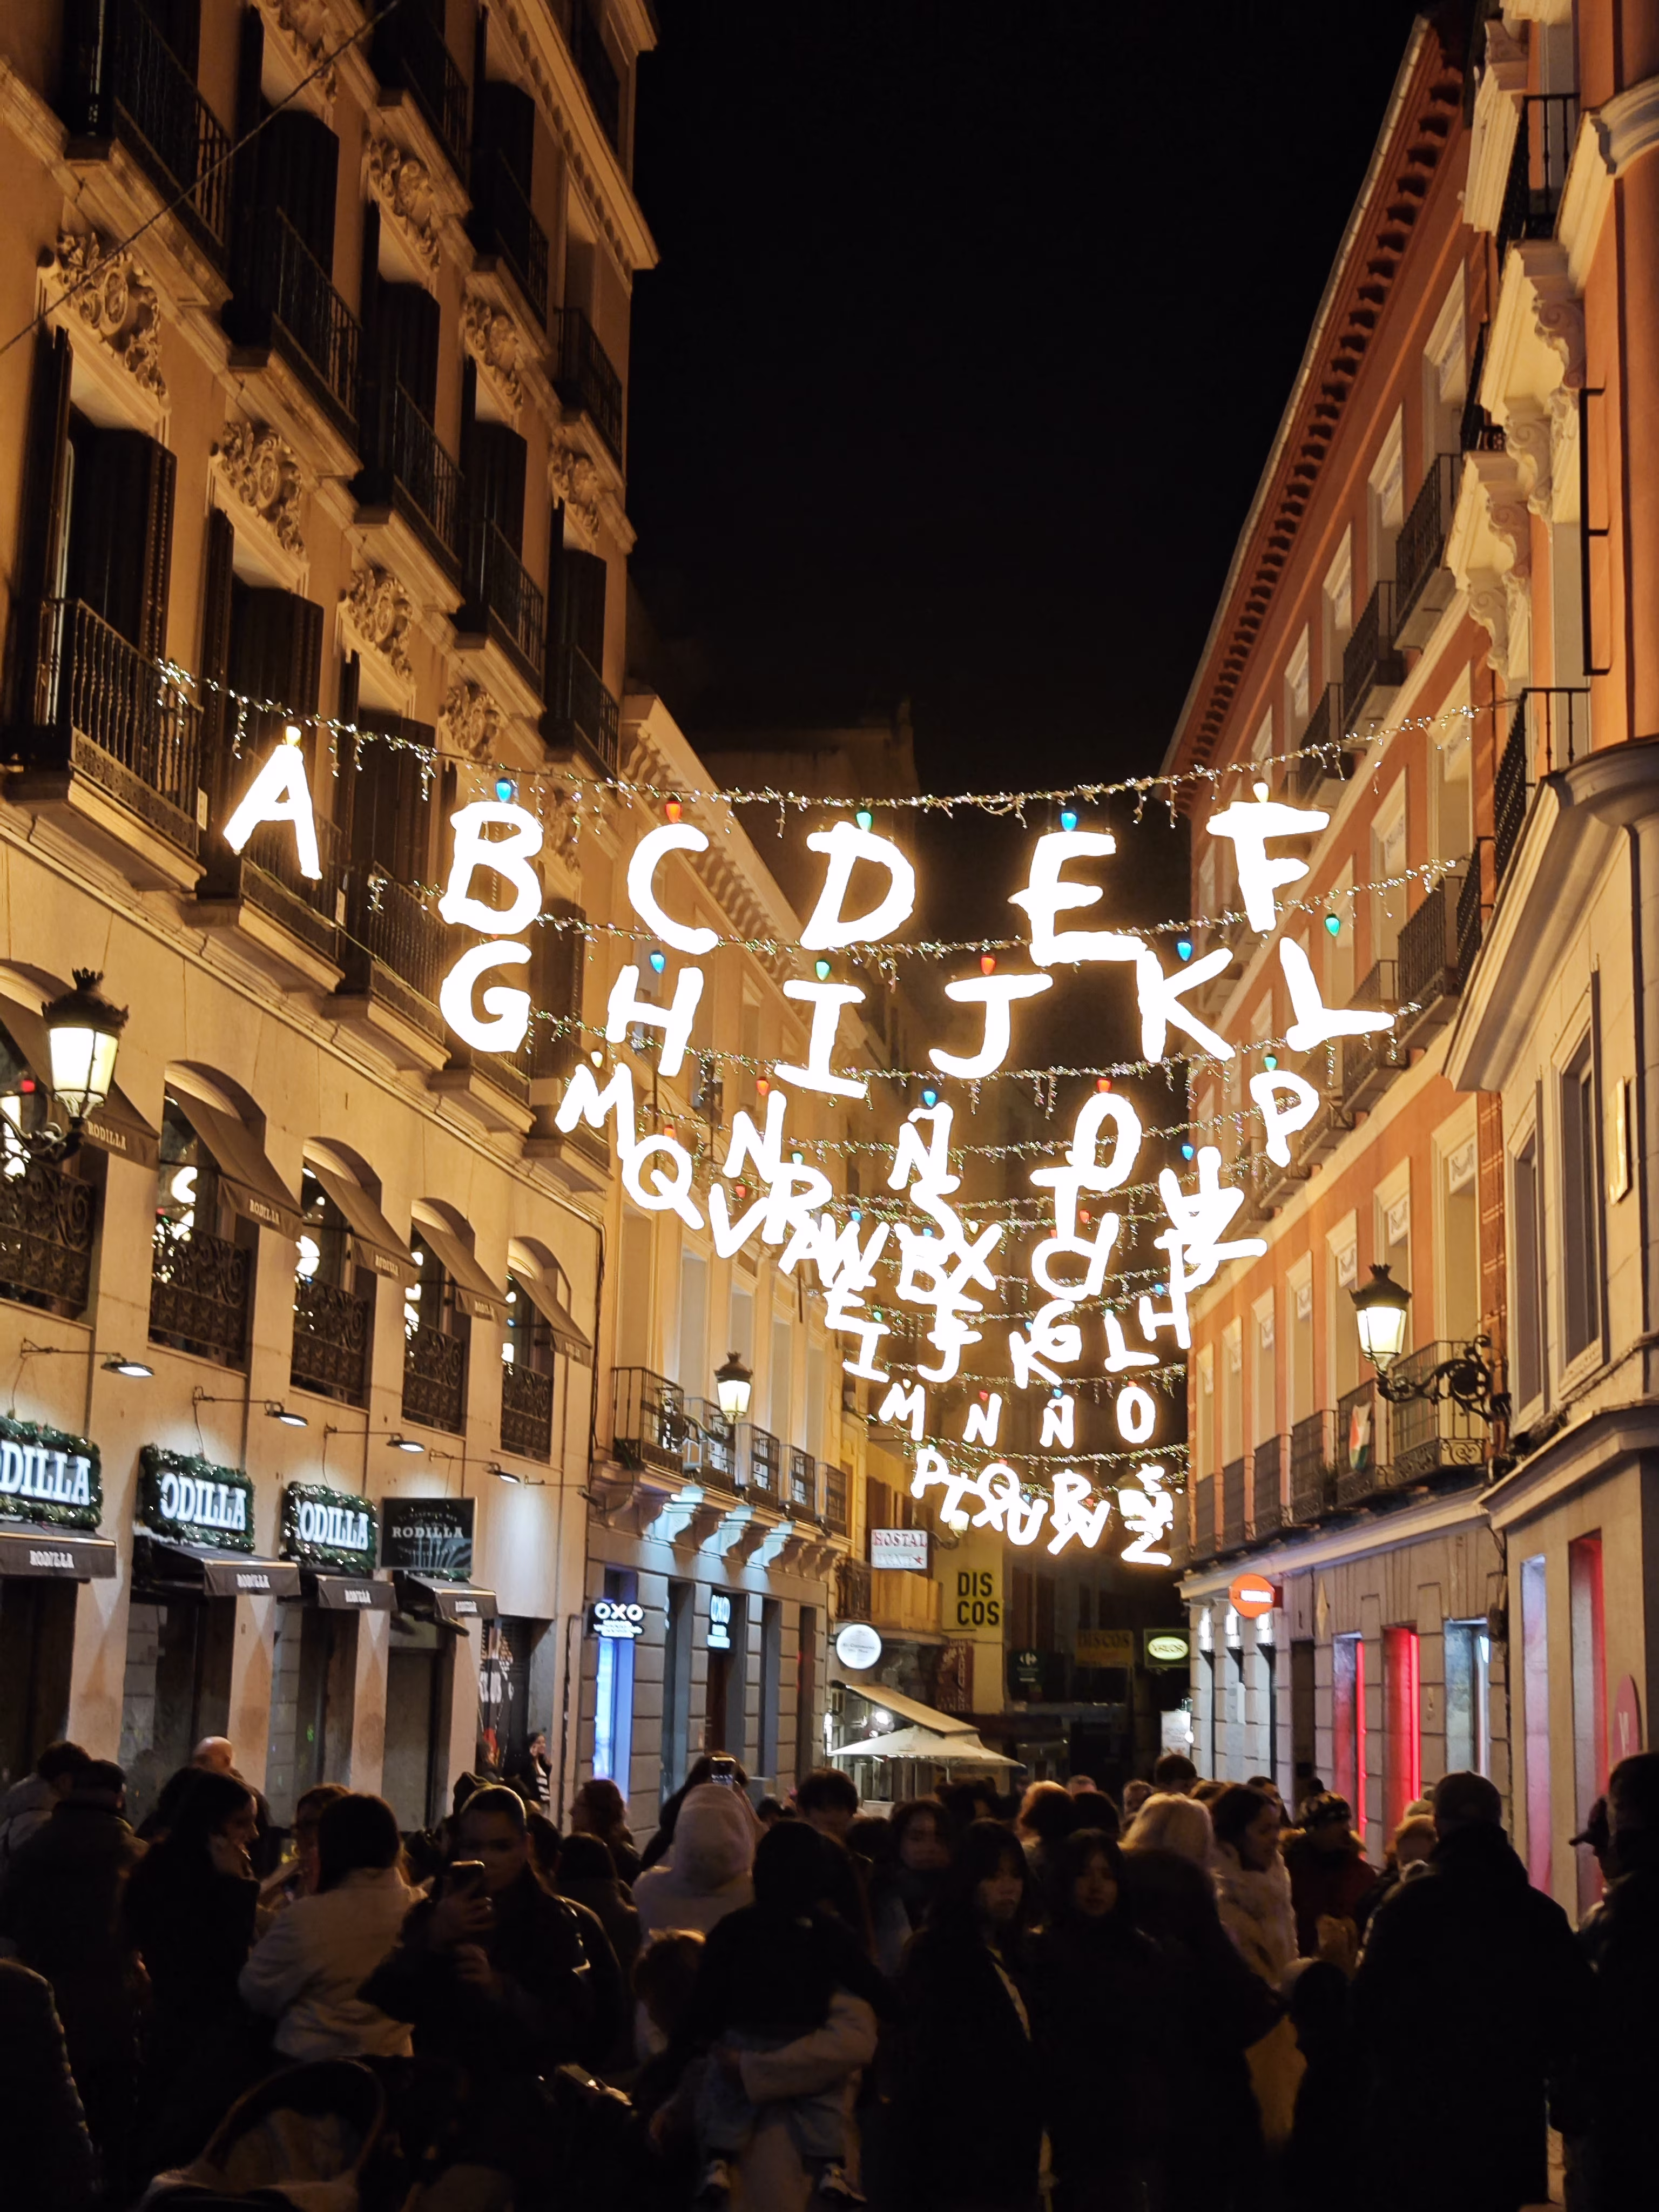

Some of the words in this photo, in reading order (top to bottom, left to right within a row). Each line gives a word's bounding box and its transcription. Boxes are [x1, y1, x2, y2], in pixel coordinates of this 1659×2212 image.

[224, 745, 322, 880] A
[438, 801, 542, 935] B
[627, 823, 719, 955] C
[800, 821, 915, 950] D
[1008, 831, 1145, 966] E
[1205, 801, 1330, 933] F
[440, 940, 531, 1053] G
[606, 965, 704, 1077] H
[774, 980, 867, 1099] I
[928, 974, 1054, 1079] J
[1136, 947, 1235, 1063] K
[1279, 938, 1395, 1051] L
[87, 1120, 127, 1151] RODILLA
[555, 1063, 636, 1159] M
[722, 1090, 787, 1183] N
[1072, 1092, 1143, 1192] O
[1249, 1069, 1319, 1168] P
[249, 1198, 280, 1225] RODILLA
[622, 1134, 704, 1230] Q
[708, 1183, 776, 1259] V
[1008, 1331, 1063, 1389] K
[1104, 1311, 1161, 1372] L
[1031, 1299, 1082, 1363] G
[1138, 1290, 1191, 1350] H
[878, 1382, 926, 1441] M
[962, 1393, 1002, 1447] N
[1116, 1386, 1156, 1444] O
[0, 1439, 91, 1506] DILLA
[159, 1472, 247, 1531] ODILLA
[910, 1448, 949, 1500] P
[29, 1549, 75, 1569] RODILLA
[392, 1526, 464, 1539] RODILLA
[873, 1532, 927, 1547] HOSTAL
[594, 1602, 644, 1621] OXO
[957, 1572, 993, 1597] DIS
[957, 1600, 1000, 1626] COS
